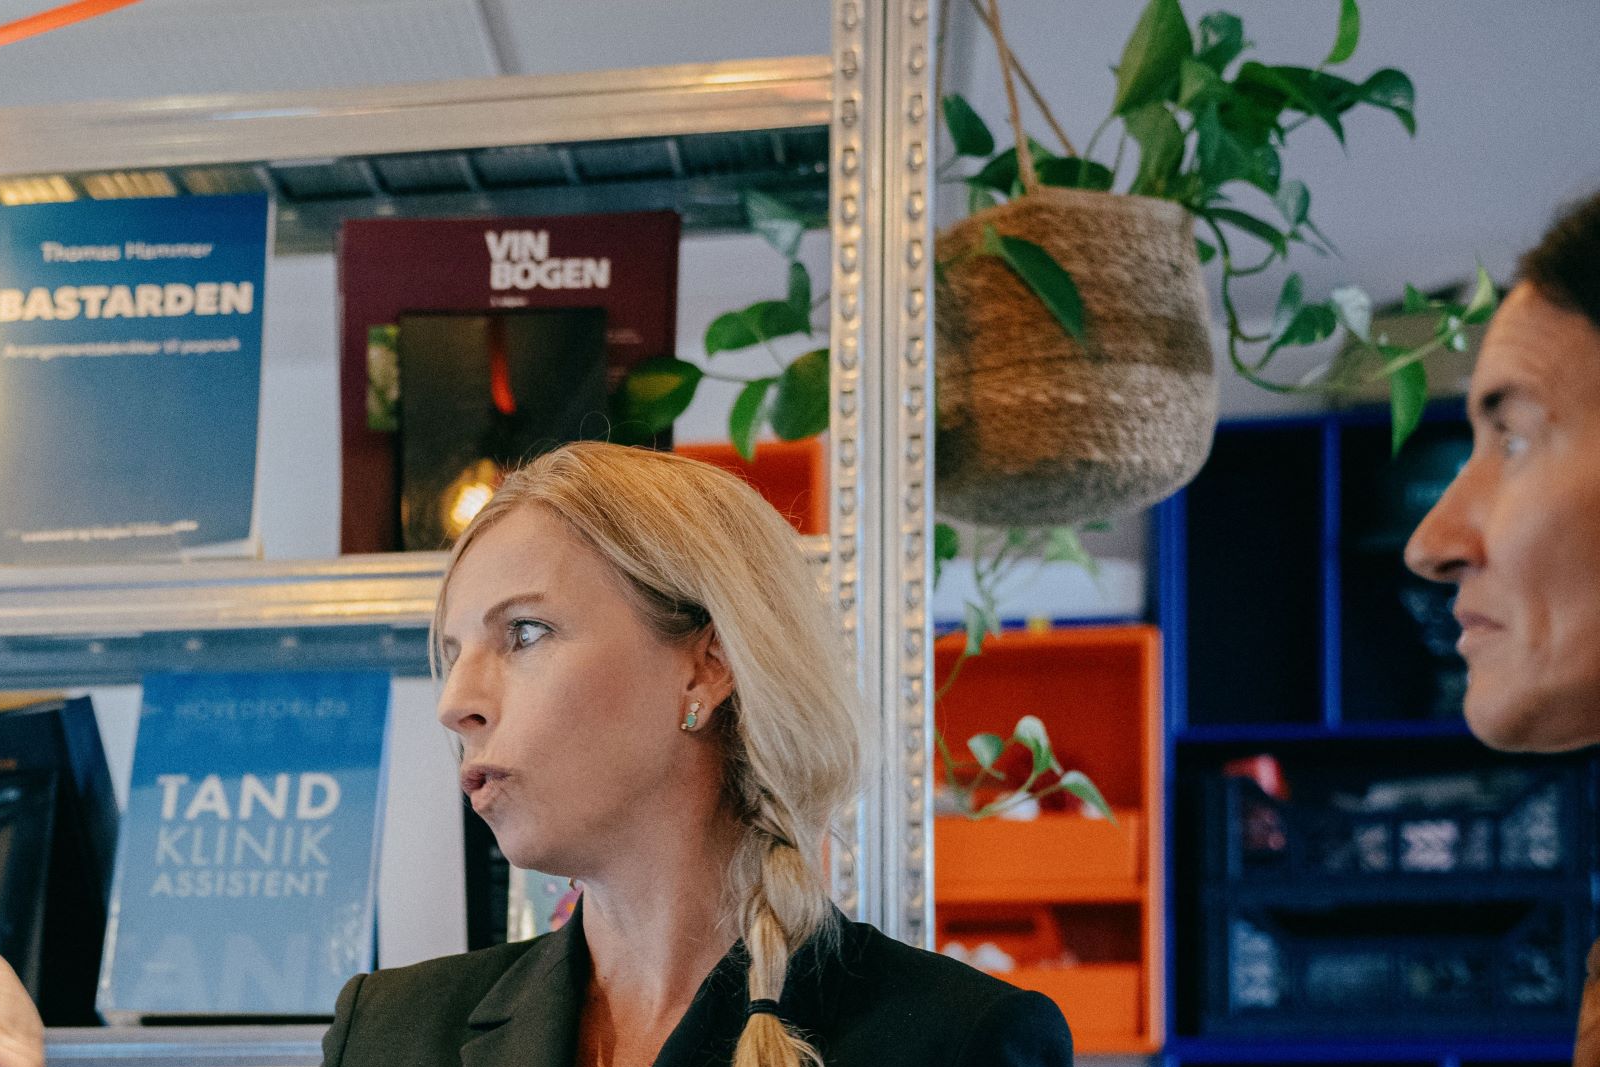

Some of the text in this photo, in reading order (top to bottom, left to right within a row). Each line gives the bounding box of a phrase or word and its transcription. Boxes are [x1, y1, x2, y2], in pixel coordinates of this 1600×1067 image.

[41, 240, 213, 263] Thomas Hammer
[484, 230, 549, 261] VIN
[489, 257, 612, 291] BOGEN
[157, 771, 342, 821] TAND
[155, 823, 333, 867] KLINIK
[150, 870, 331, 897] ASSISTENT
